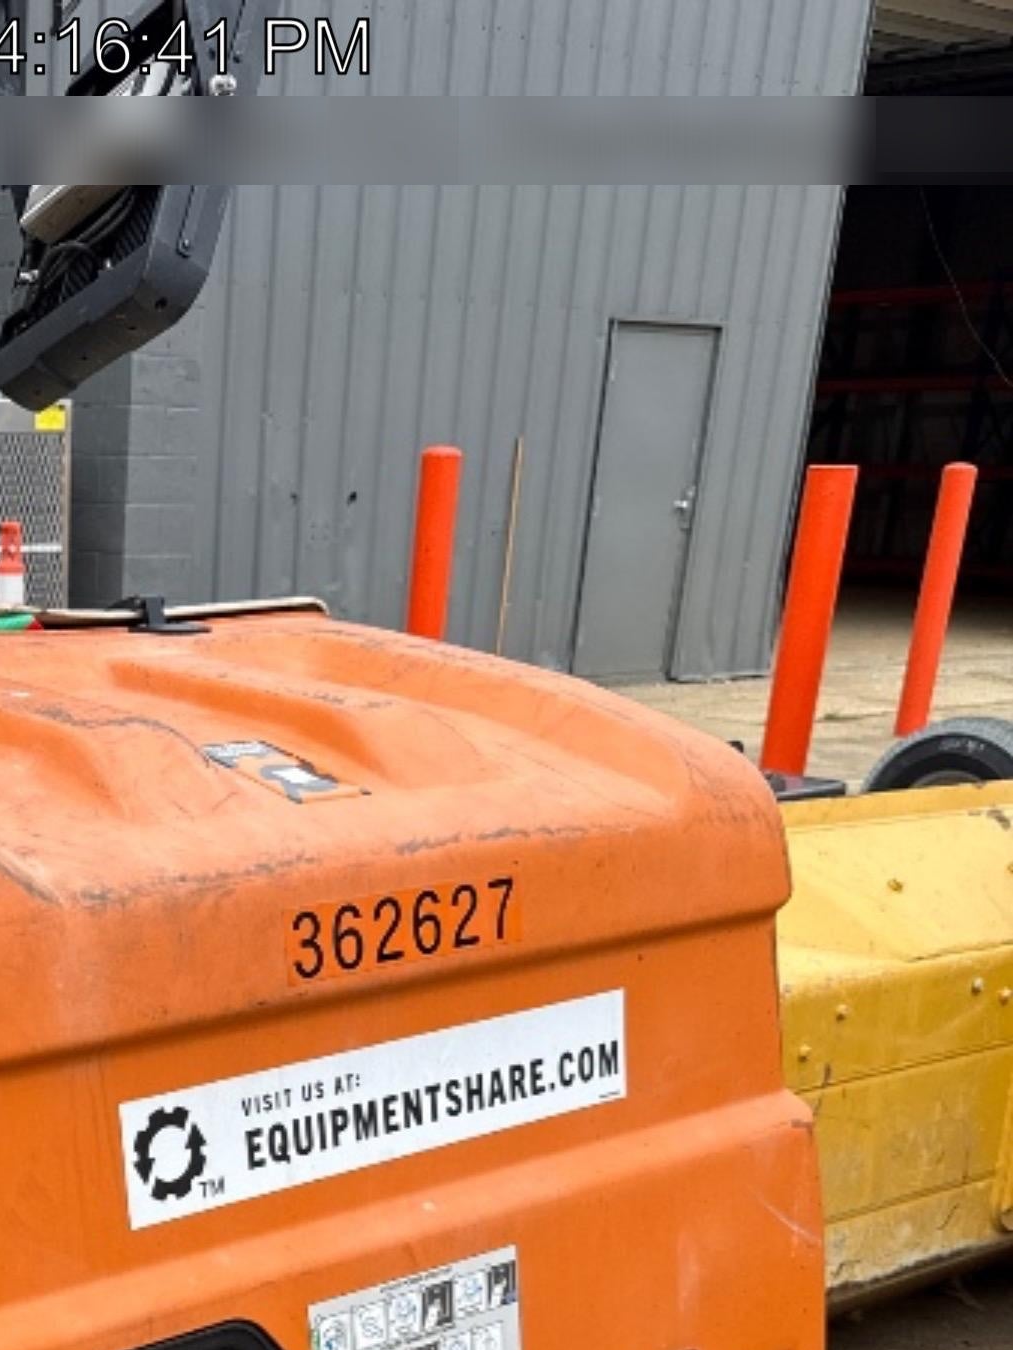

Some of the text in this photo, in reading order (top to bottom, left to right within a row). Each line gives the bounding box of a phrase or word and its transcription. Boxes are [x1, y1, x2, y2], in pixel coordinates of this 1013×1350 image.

[291, 877, 515, 979] 362627
[241, 1072, 361, 1117] VISIT US AT:
[244, 1040, 619, 1169] EQUIPMENTSHARE.COM
